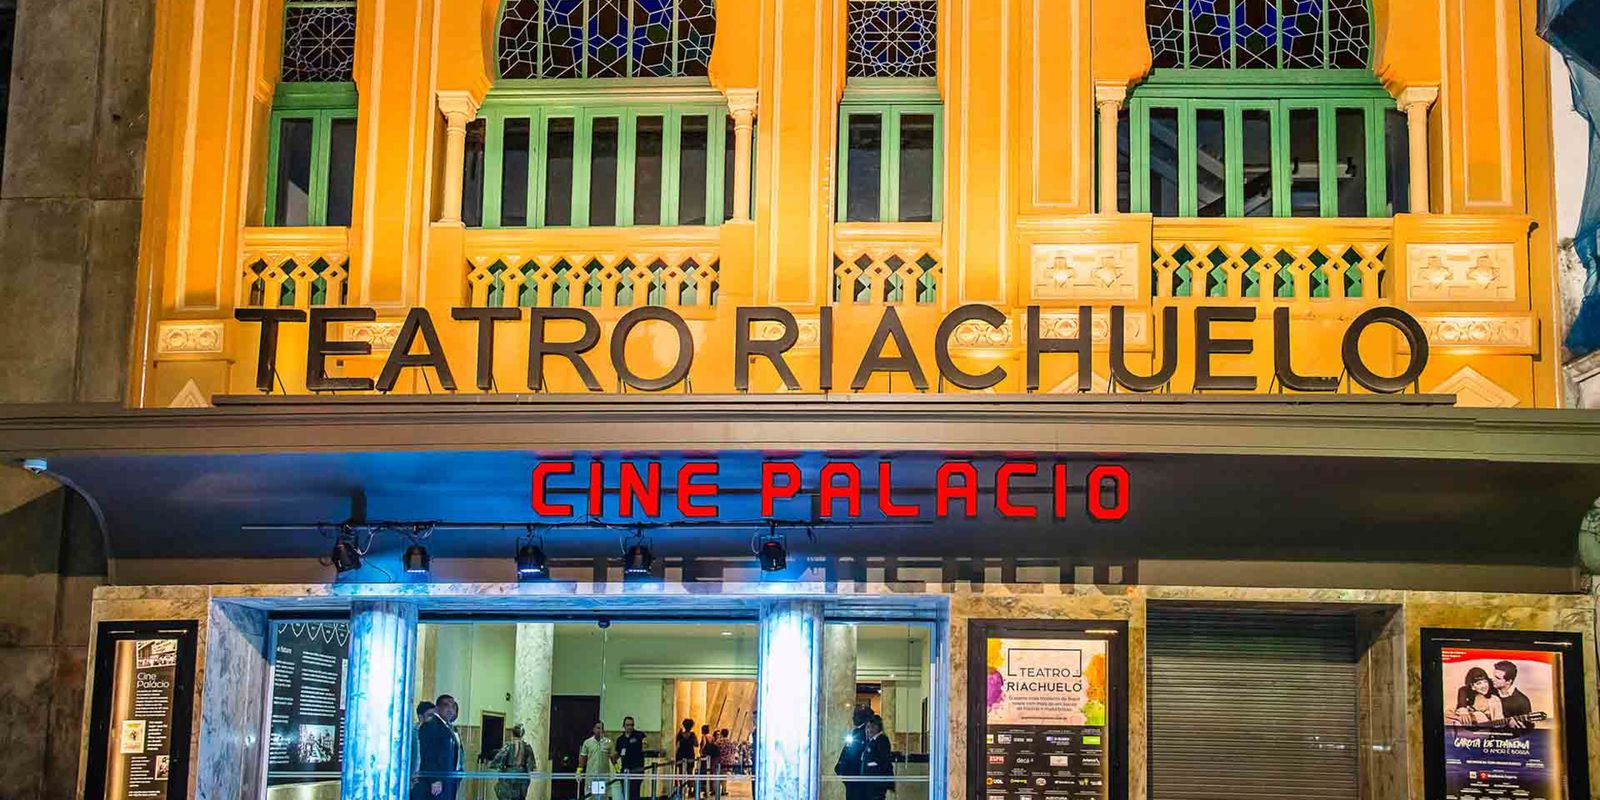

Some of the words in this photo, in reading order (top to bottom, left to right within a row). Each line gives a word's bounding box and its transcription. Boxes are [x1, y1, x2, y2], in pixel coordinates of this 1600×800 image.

[234, 306, 694, 393] TEATRO
[734, 304, 1429, 394] RIACHUELO
[531, 461, 719, 518] CINE
[761, 461, 1131, 520] PALACIO
[137, 672, 157, 680] Cine
[1020, 667, 1070, 677] TEATRO
[136, 680, 169, 688] Palácio
[1007, 682, 1082, 692] RIACHUELO
[1454, 737, 1480, 750] GAROTA
